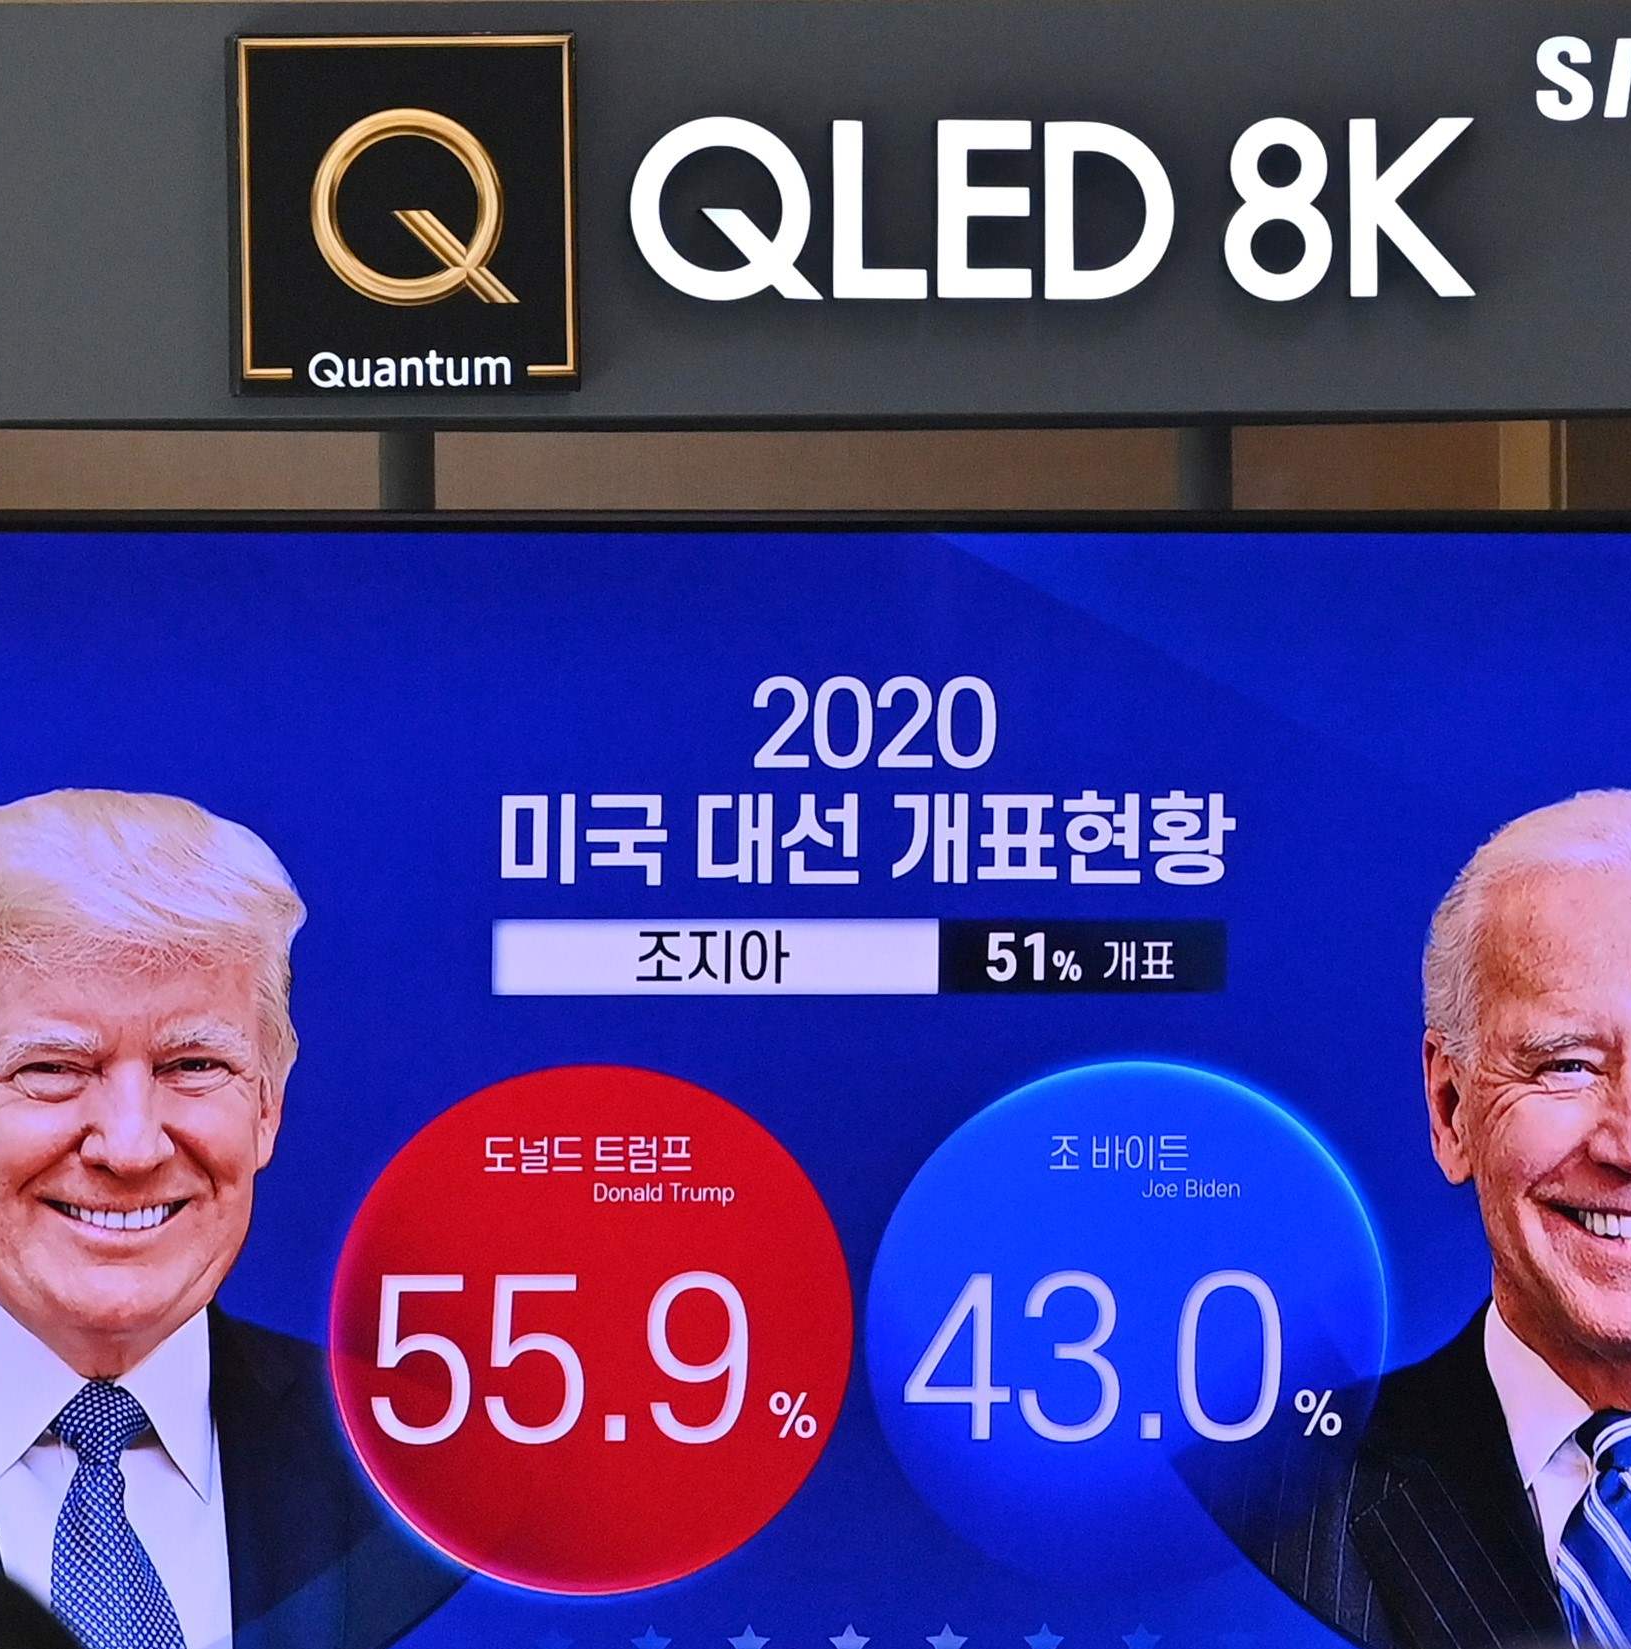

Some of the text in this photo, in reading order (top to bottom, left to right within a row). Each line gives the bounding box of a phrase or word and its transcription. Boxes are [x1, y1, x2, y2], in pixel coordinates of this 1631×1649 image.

[311, 108, 520, 307] Q
[629, 116, 1476, 302] QLED 8K
[307, 349, 512, 390] Quantum
[753, 675, 997, 769] 2020
[500, 790, 1237, 886] 미국 대선 개표현황
[636, 929, 790, 985] 조지아
[985, 932, 1175, 984] 51% 개표
[483, 1135, 692, 1174] 도널드 트럼프
[1049, 1134, 1190, 1172] 조 바이든
[593, 1182, 735, 1207] Donald Trump
[1141, 1178, 1241, 1199] Joe Biden
[370, 1269, 817, 1446] 55.9%
[904, 1268, 1343, 1445] 43.0%
